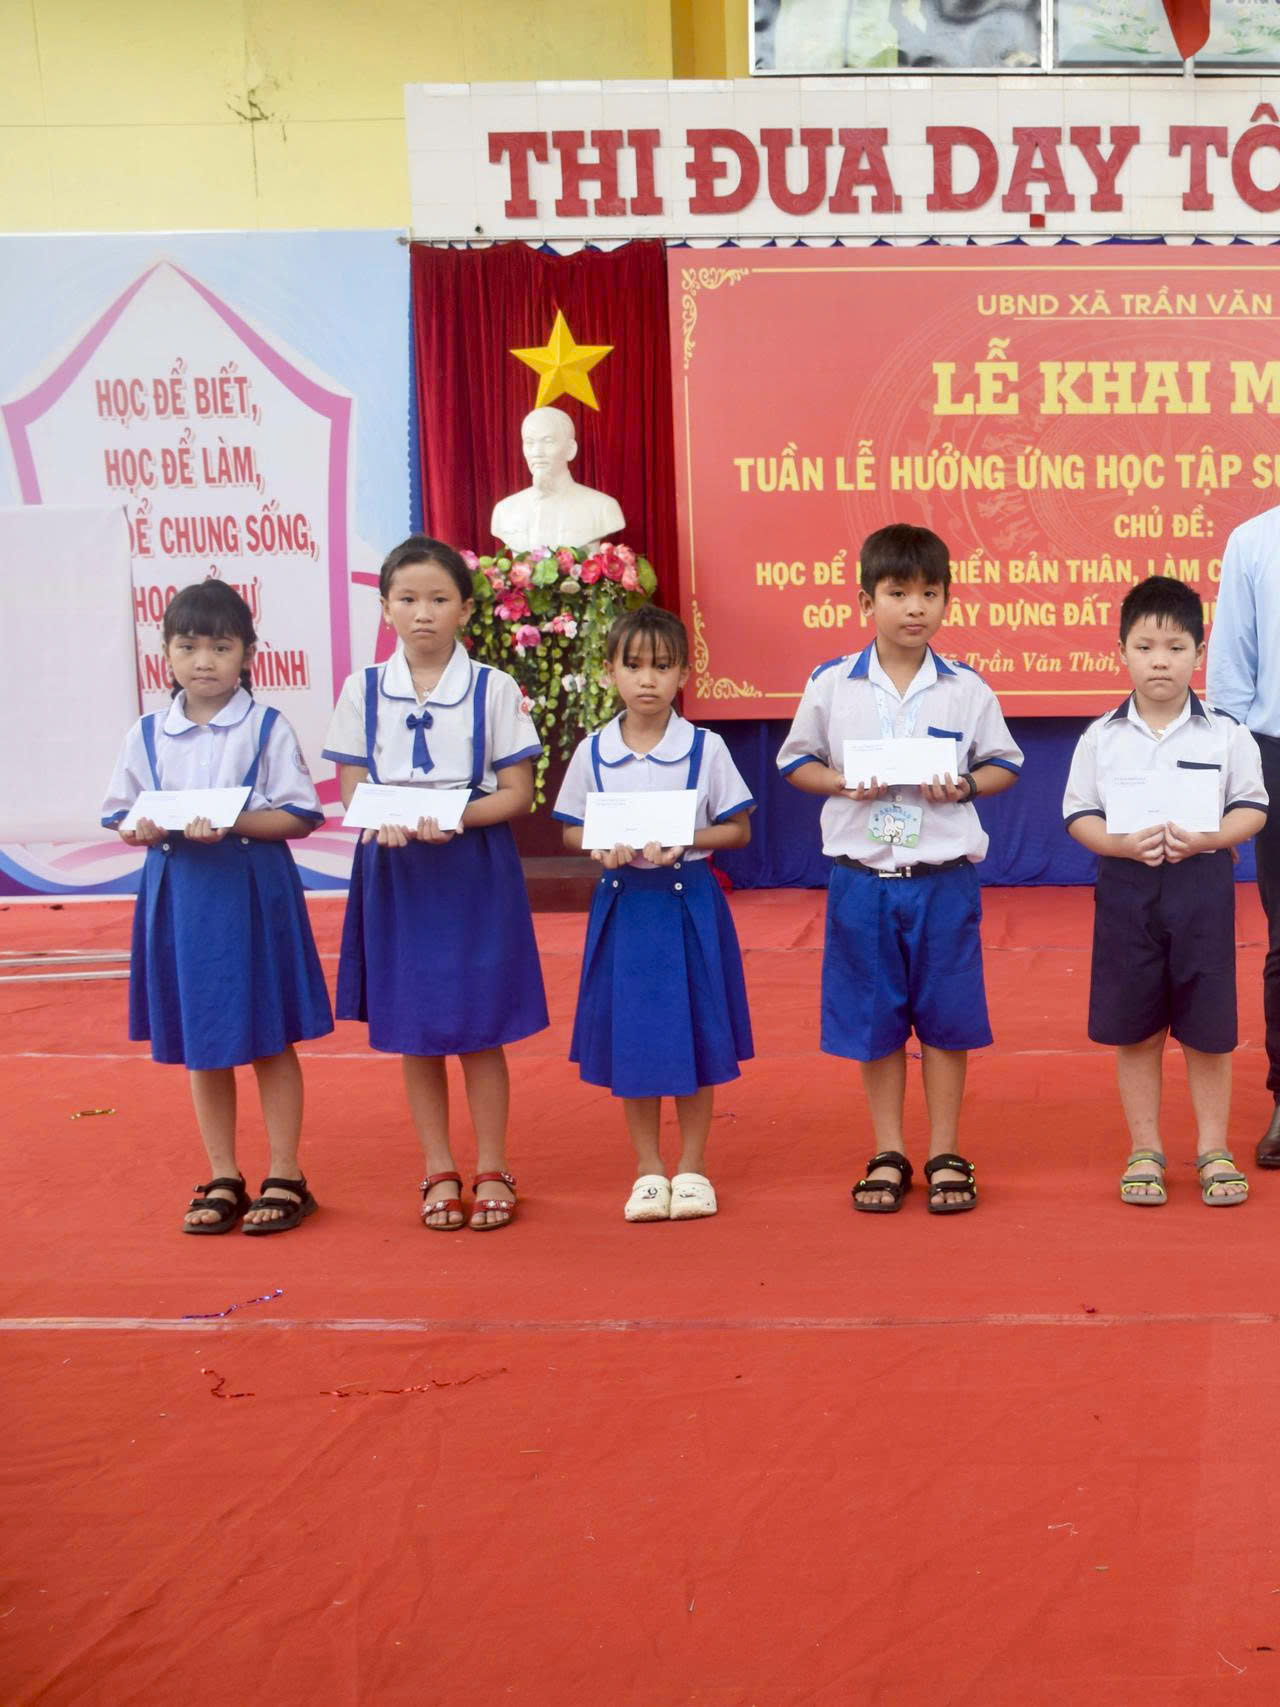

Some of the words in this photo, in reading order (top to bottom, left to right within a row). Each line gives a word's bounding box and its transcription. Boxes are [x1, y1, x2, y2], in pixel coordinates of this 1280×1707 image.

[488, 129, 663, 218] THI
[686, 128, 901, 215] ĐUA
[926, 125, 1140, 227] DẠY
[977, 295, 1058, 315] UBND
[1069, 290, 1110, 314] XÃ
[1123, 286, 1197, 314] TRẦN
[1207, 289, 1272, 315] VĂN
[96, 378, 143, 424] HỌC
[153, 357, 184, 416] ĐỂ
[194, 361, 259, 421] BIẾT,
[933, 338, 1019, 415] LỄ
[1040, 361, 1211, 415] KHAI
[104, 449, 153, 496] HỌC
[161, 427, 192, 485] ĐỂ
[202, 436, 262, 490] LÀM,
[734, 442, 824, 491] TUẦN
[836, 440, 875, 490] LỄ
[891, 443, 1004, 491] HƯỞNG
[1016, 443, 1084, 489] ỨNG
[1096, 457, 1165, 495] HỌC
[1176, 446, 1242, 495] TẬP
[160, 514, 239, 553] CHUNG
[246, 499, 316, 558] SỐNG,
[1114, 506, 1163, 538] CHỦ
[1173, 505, 1214, 538] ĐỀ:
[756, 562, 806, 590] HỌC
[813, 549, 847, 584] ĐỂ
[1009, 551, 1058, 583] BẢN
[1066, 553, 1139, 587] THÂN,
[803, 599, 851, 628] GÓP
[990, 599, 1056, 631] DỰNG
[1063, 593, 1111, 626] ĐẤT
[250, 641, 306, 686] MÌNH
[1023, 652, 1061, 672] Văn
[1069, 650, 1120, 675] Thời,
